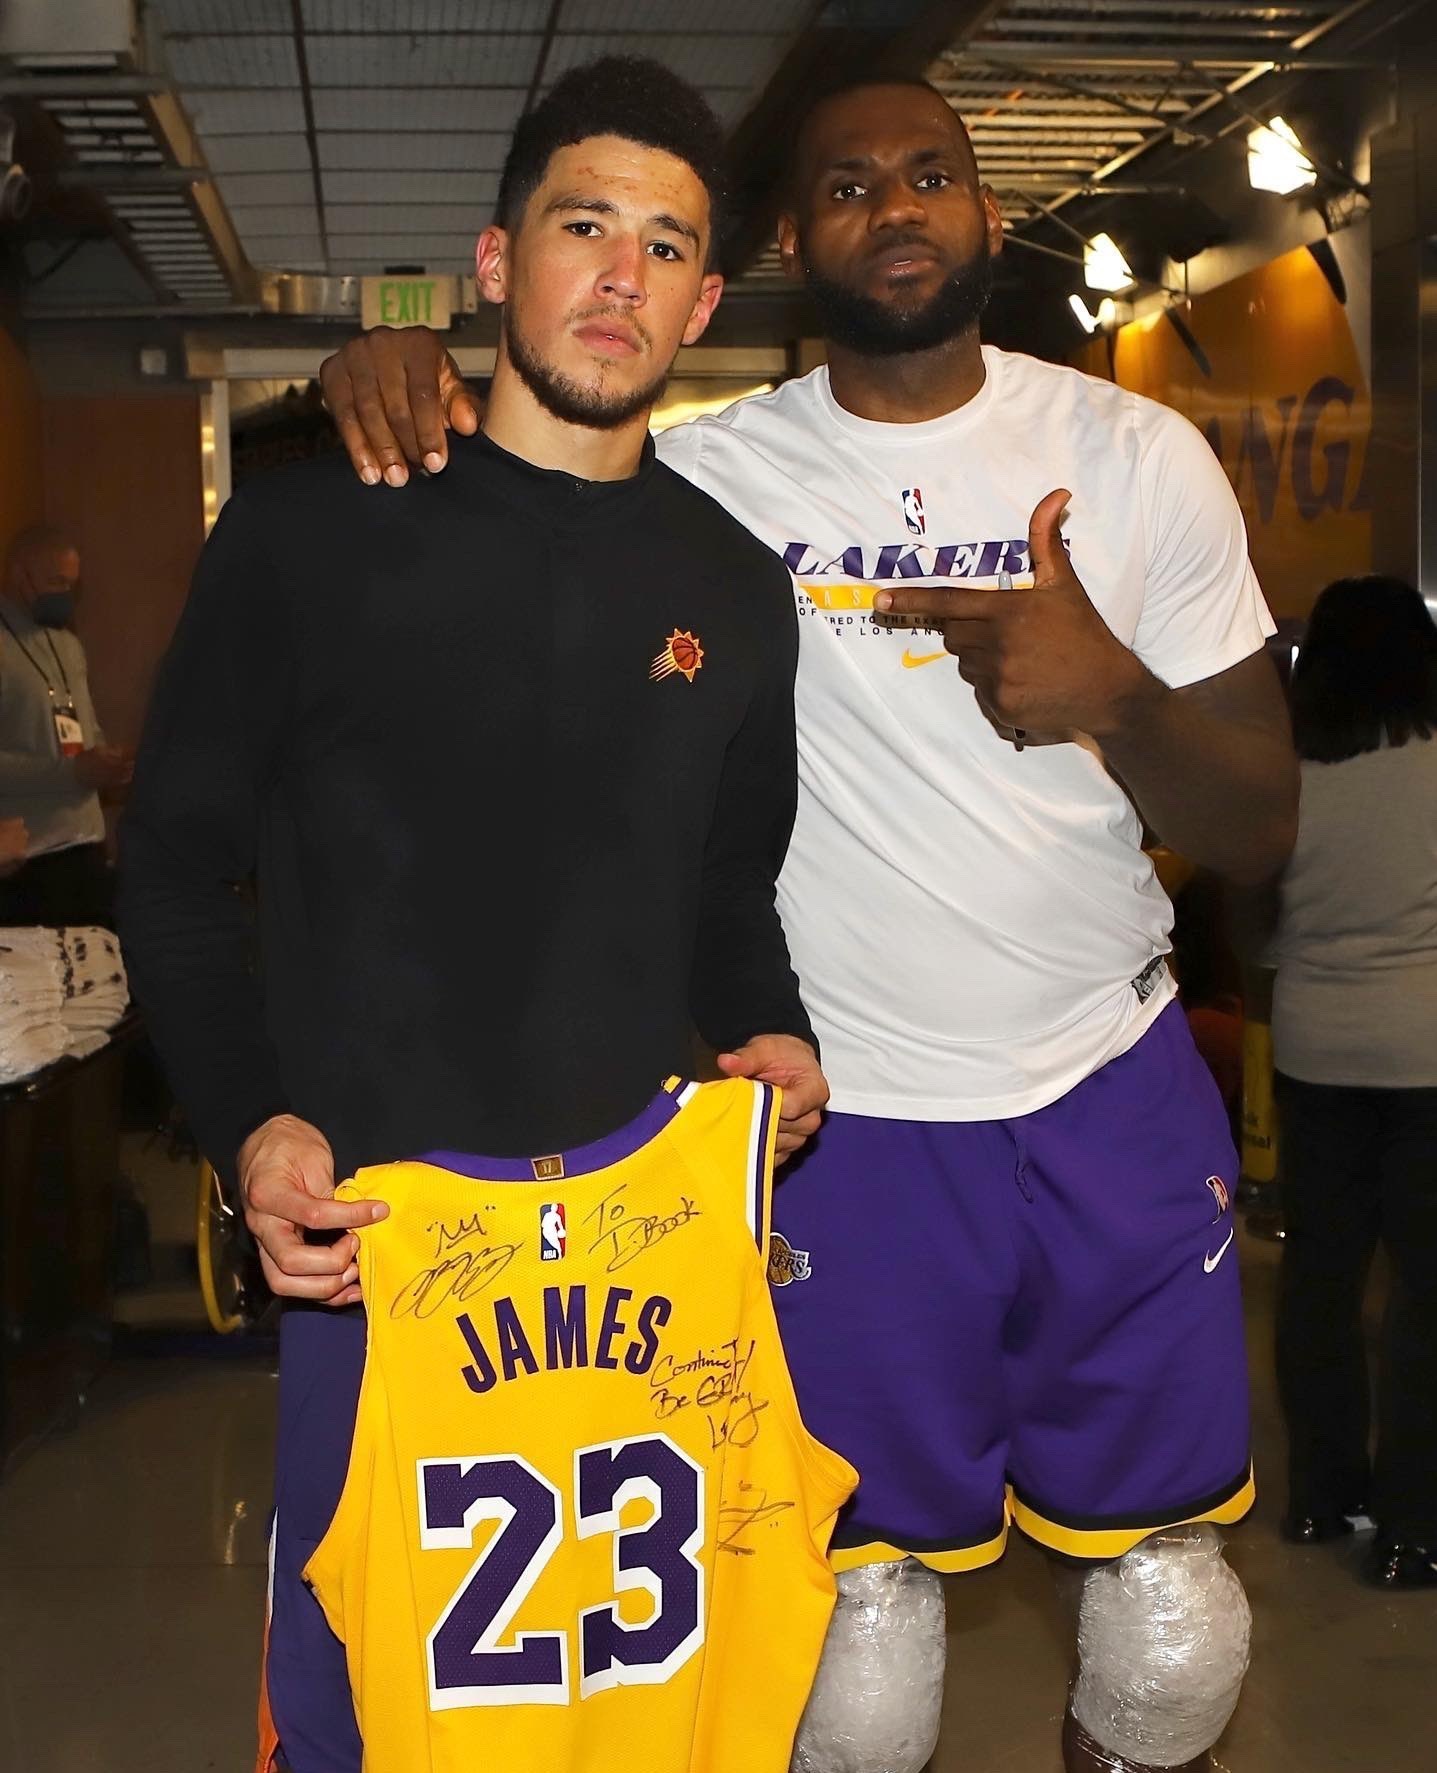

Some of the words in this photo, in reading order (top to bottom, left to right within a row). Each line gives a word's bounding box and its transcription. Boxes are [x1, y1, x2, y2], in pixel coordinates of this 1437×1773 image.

[380, 282, 436, 323] EXIT
[1204, 376, 1372, 524] NG
[782, 538, 1071, 580] LAKER
[860, 627, 893, 636] LOS
[543, 1249, 557, 1260] NBA
[456, 1285, 672, 1393] JAMES
[416, 1432, 706, 1711] 23
